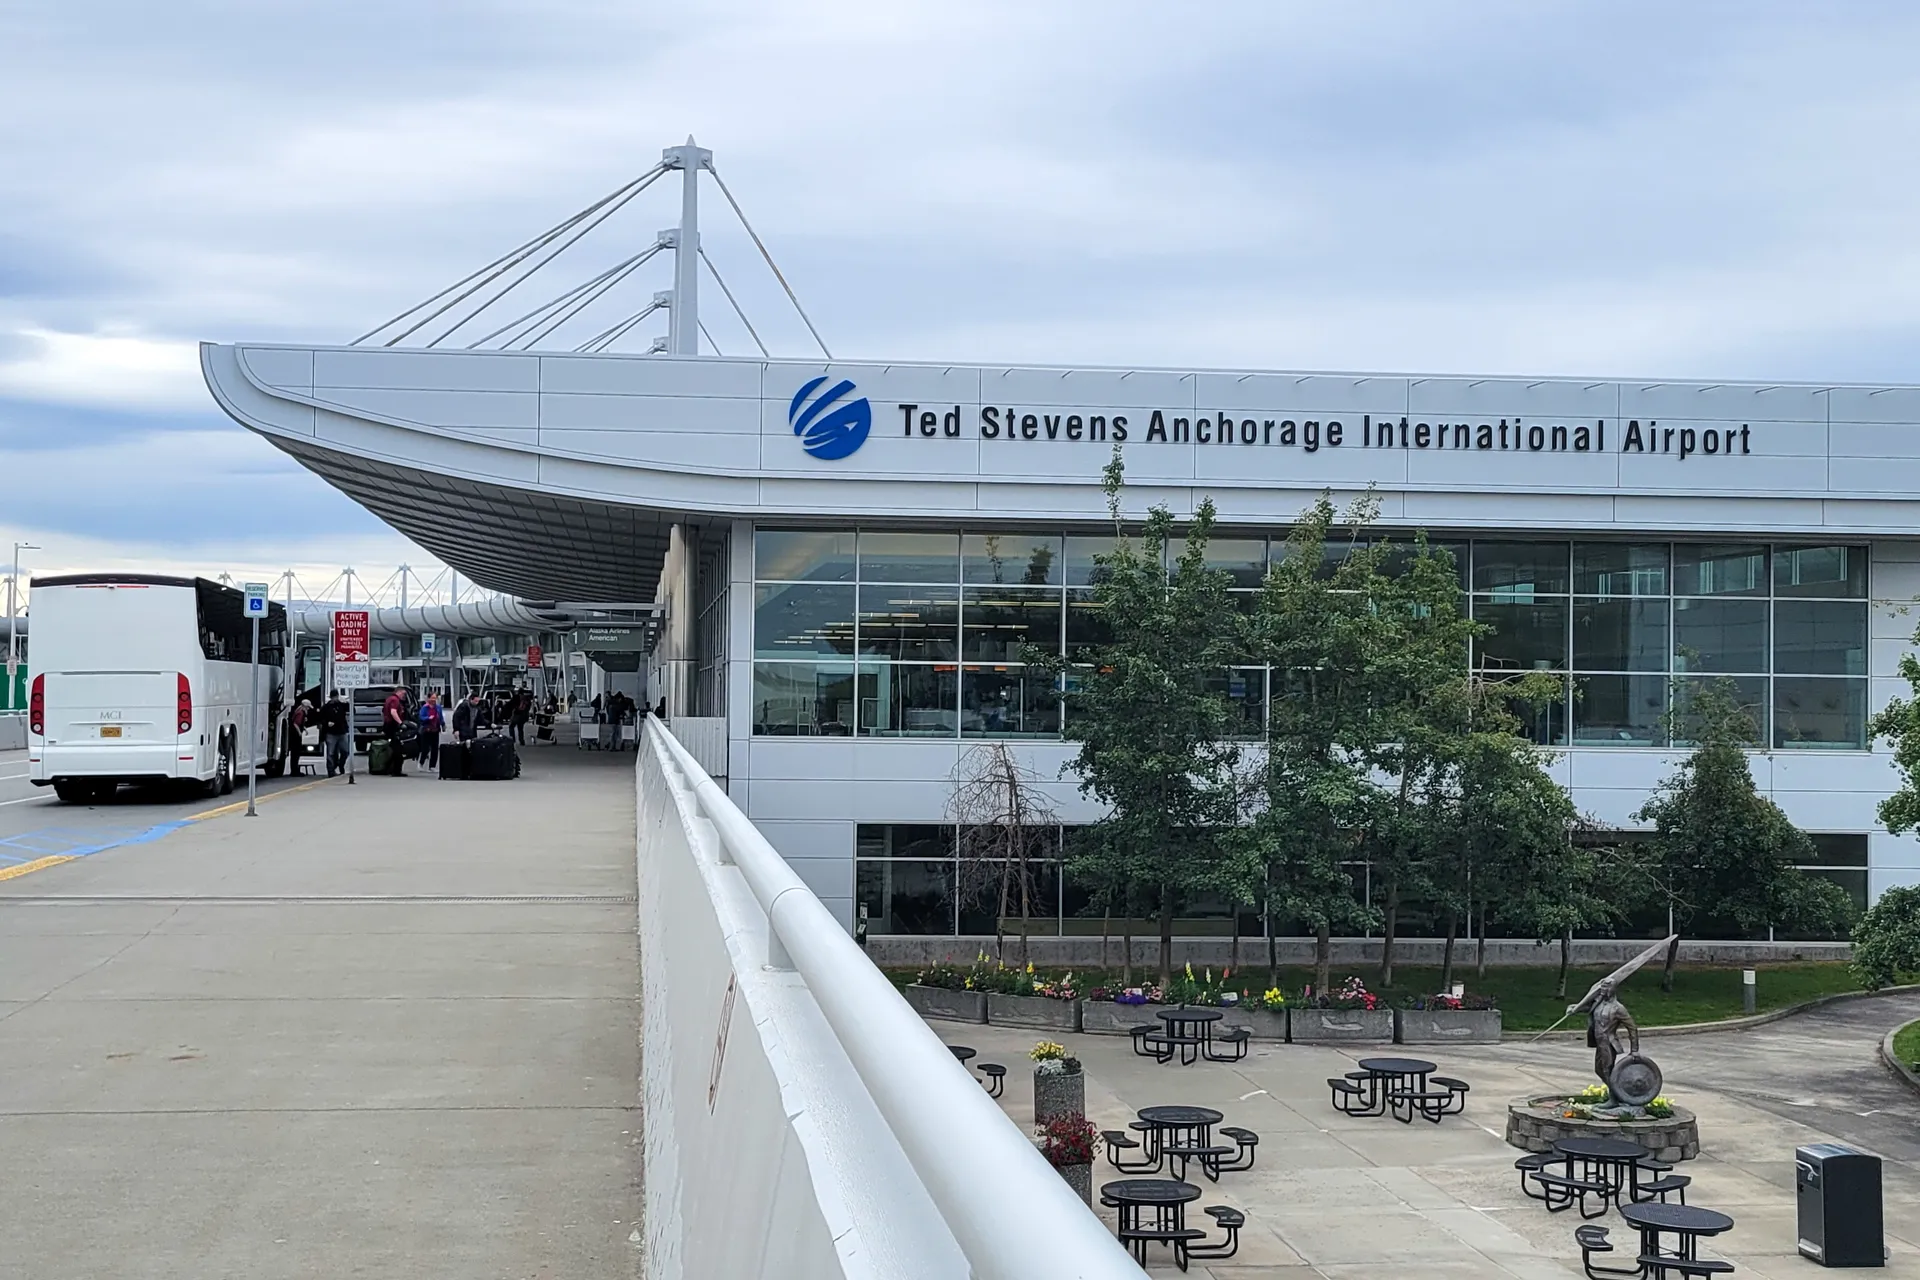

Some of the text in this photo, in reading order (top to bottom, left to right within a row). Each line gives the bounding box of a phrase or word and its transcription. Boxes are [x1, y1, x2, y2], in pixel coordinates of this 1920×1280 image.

[898, 404, 1751, 461] Ted Stevens Anchorage International Airport
[340, 613, 364, 621] ACTIVE
[337, 621, 367, 629] LOADING
[572, 631, 578, 645] 1
[336, 665, 367, 673] Uber/Lyft
[100, 710, 122, 720] MCI
